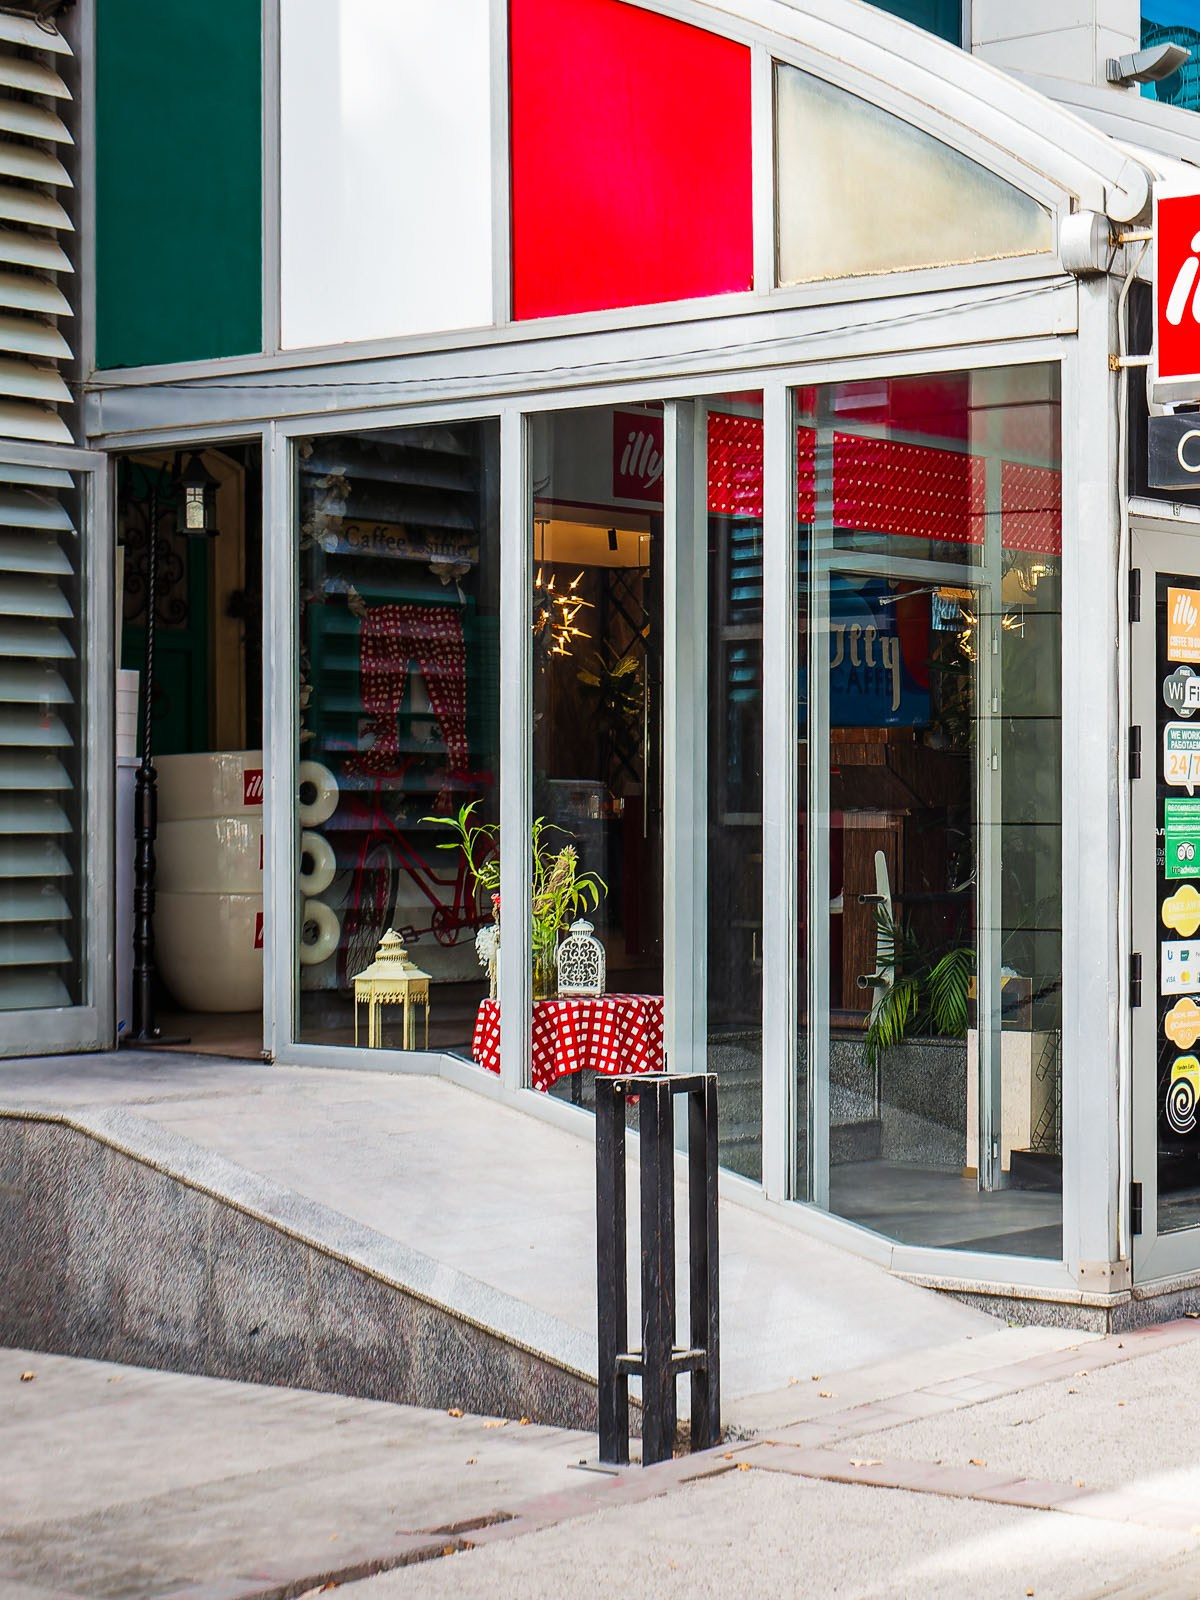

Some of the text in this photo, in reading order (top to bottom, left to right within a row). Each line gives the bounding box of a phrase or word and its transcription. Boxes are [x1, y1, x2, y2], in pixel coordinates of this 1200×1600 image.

[620, 430, 664, 489] illy
[1172, 593, 1199, 633] illy
[1170, 730, 1200, 741] WE WORK
